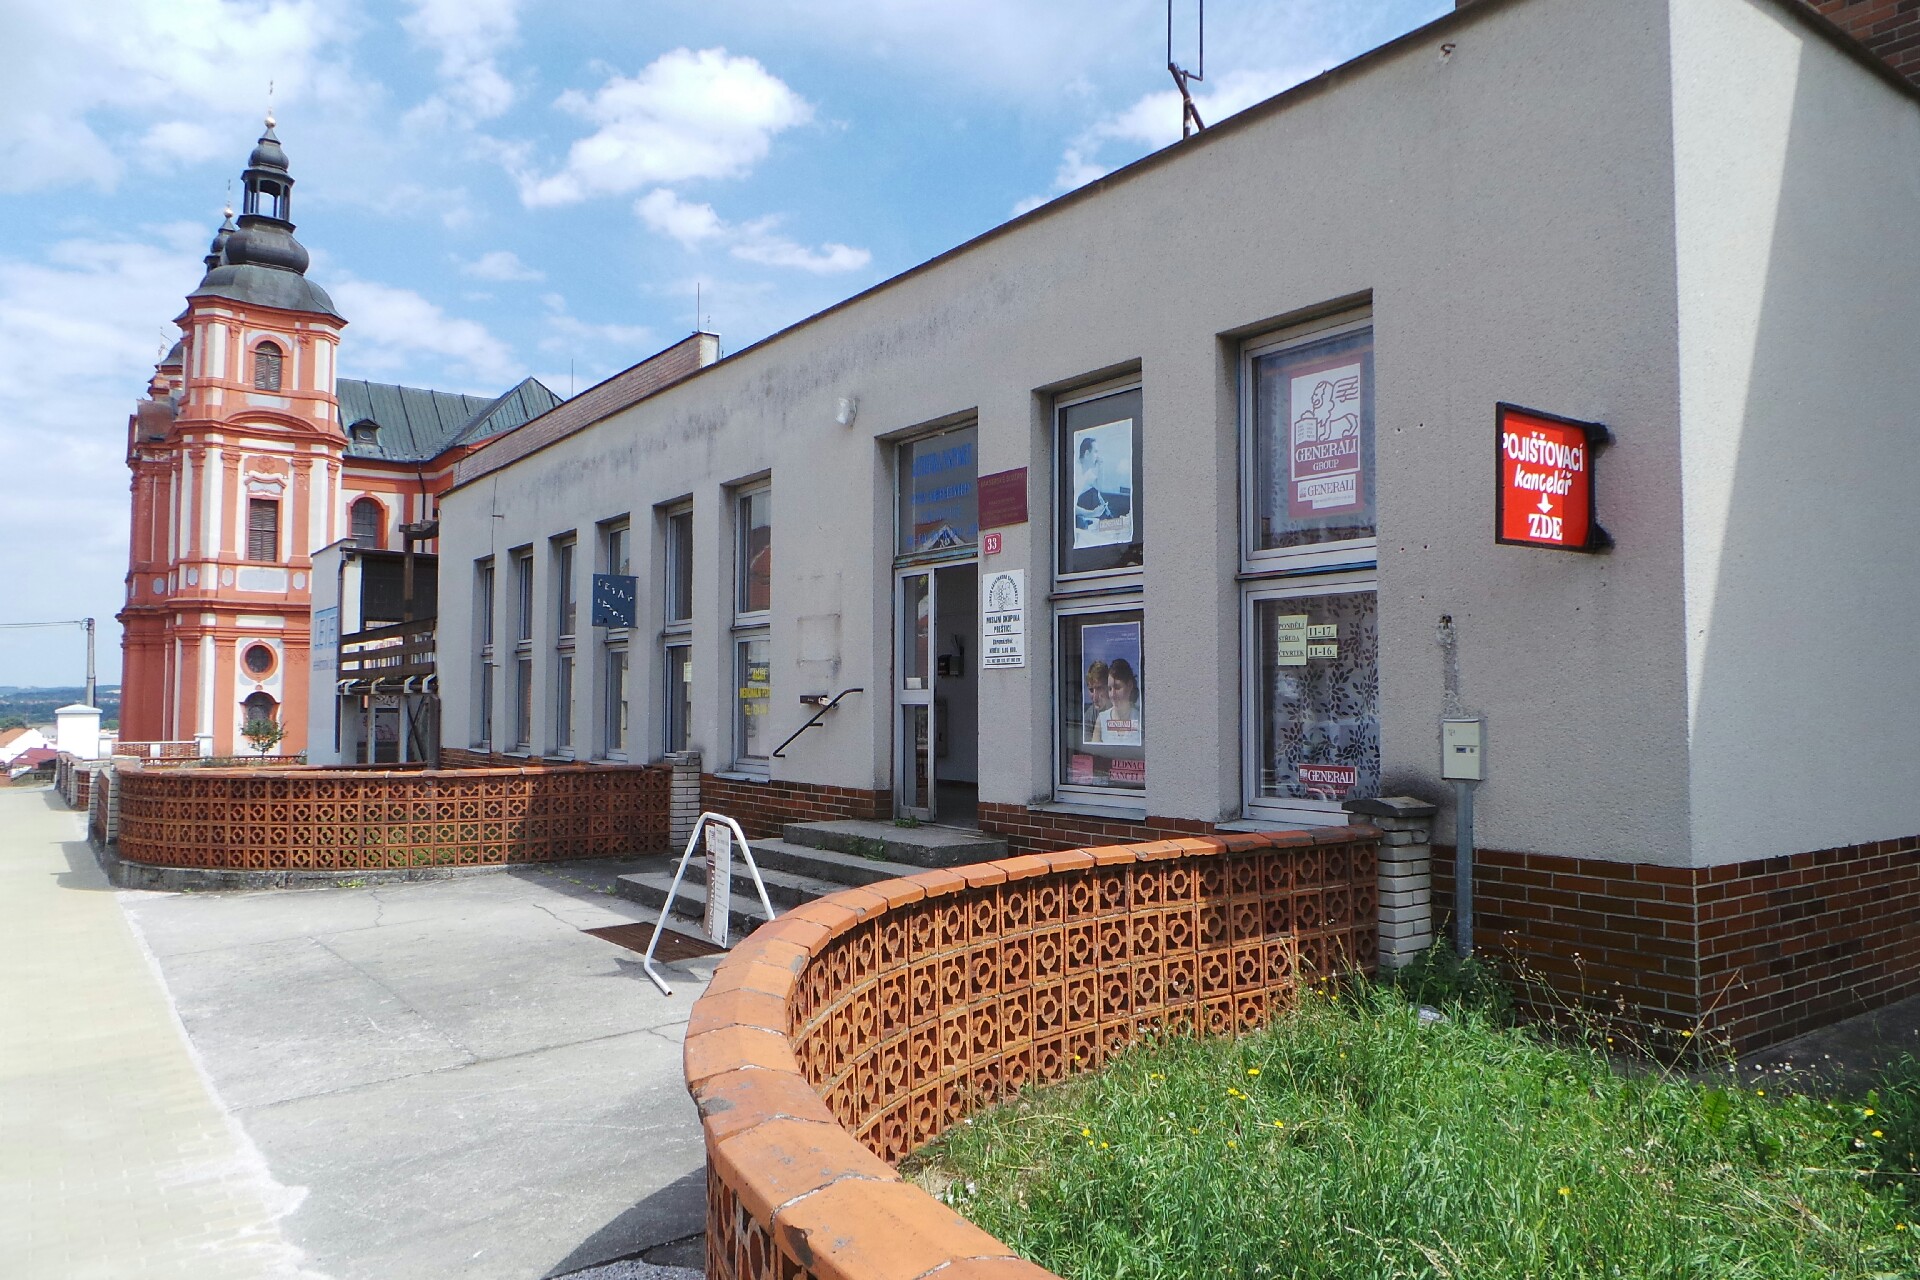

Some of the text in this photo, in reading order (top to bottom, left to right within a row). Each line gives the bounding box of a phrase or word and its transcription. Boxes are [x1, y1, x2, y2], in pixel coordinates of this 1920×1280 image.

[1295, 438, 1357, 463] GENERALI
[1312, 459, 1339, 471] GROUP
[1514, 464, 1572, 496] kancelář
[1307, 479, 1355, 497] GENERALI
[1528, 513, 1563, 541] ZDE
[987, 537, 997, 550] 33
[1309, 626, 1331, 636] 11-17
[1309, 647, 1332, 656] 11-16
[1308, 769, 1354, 784] GENERALI
